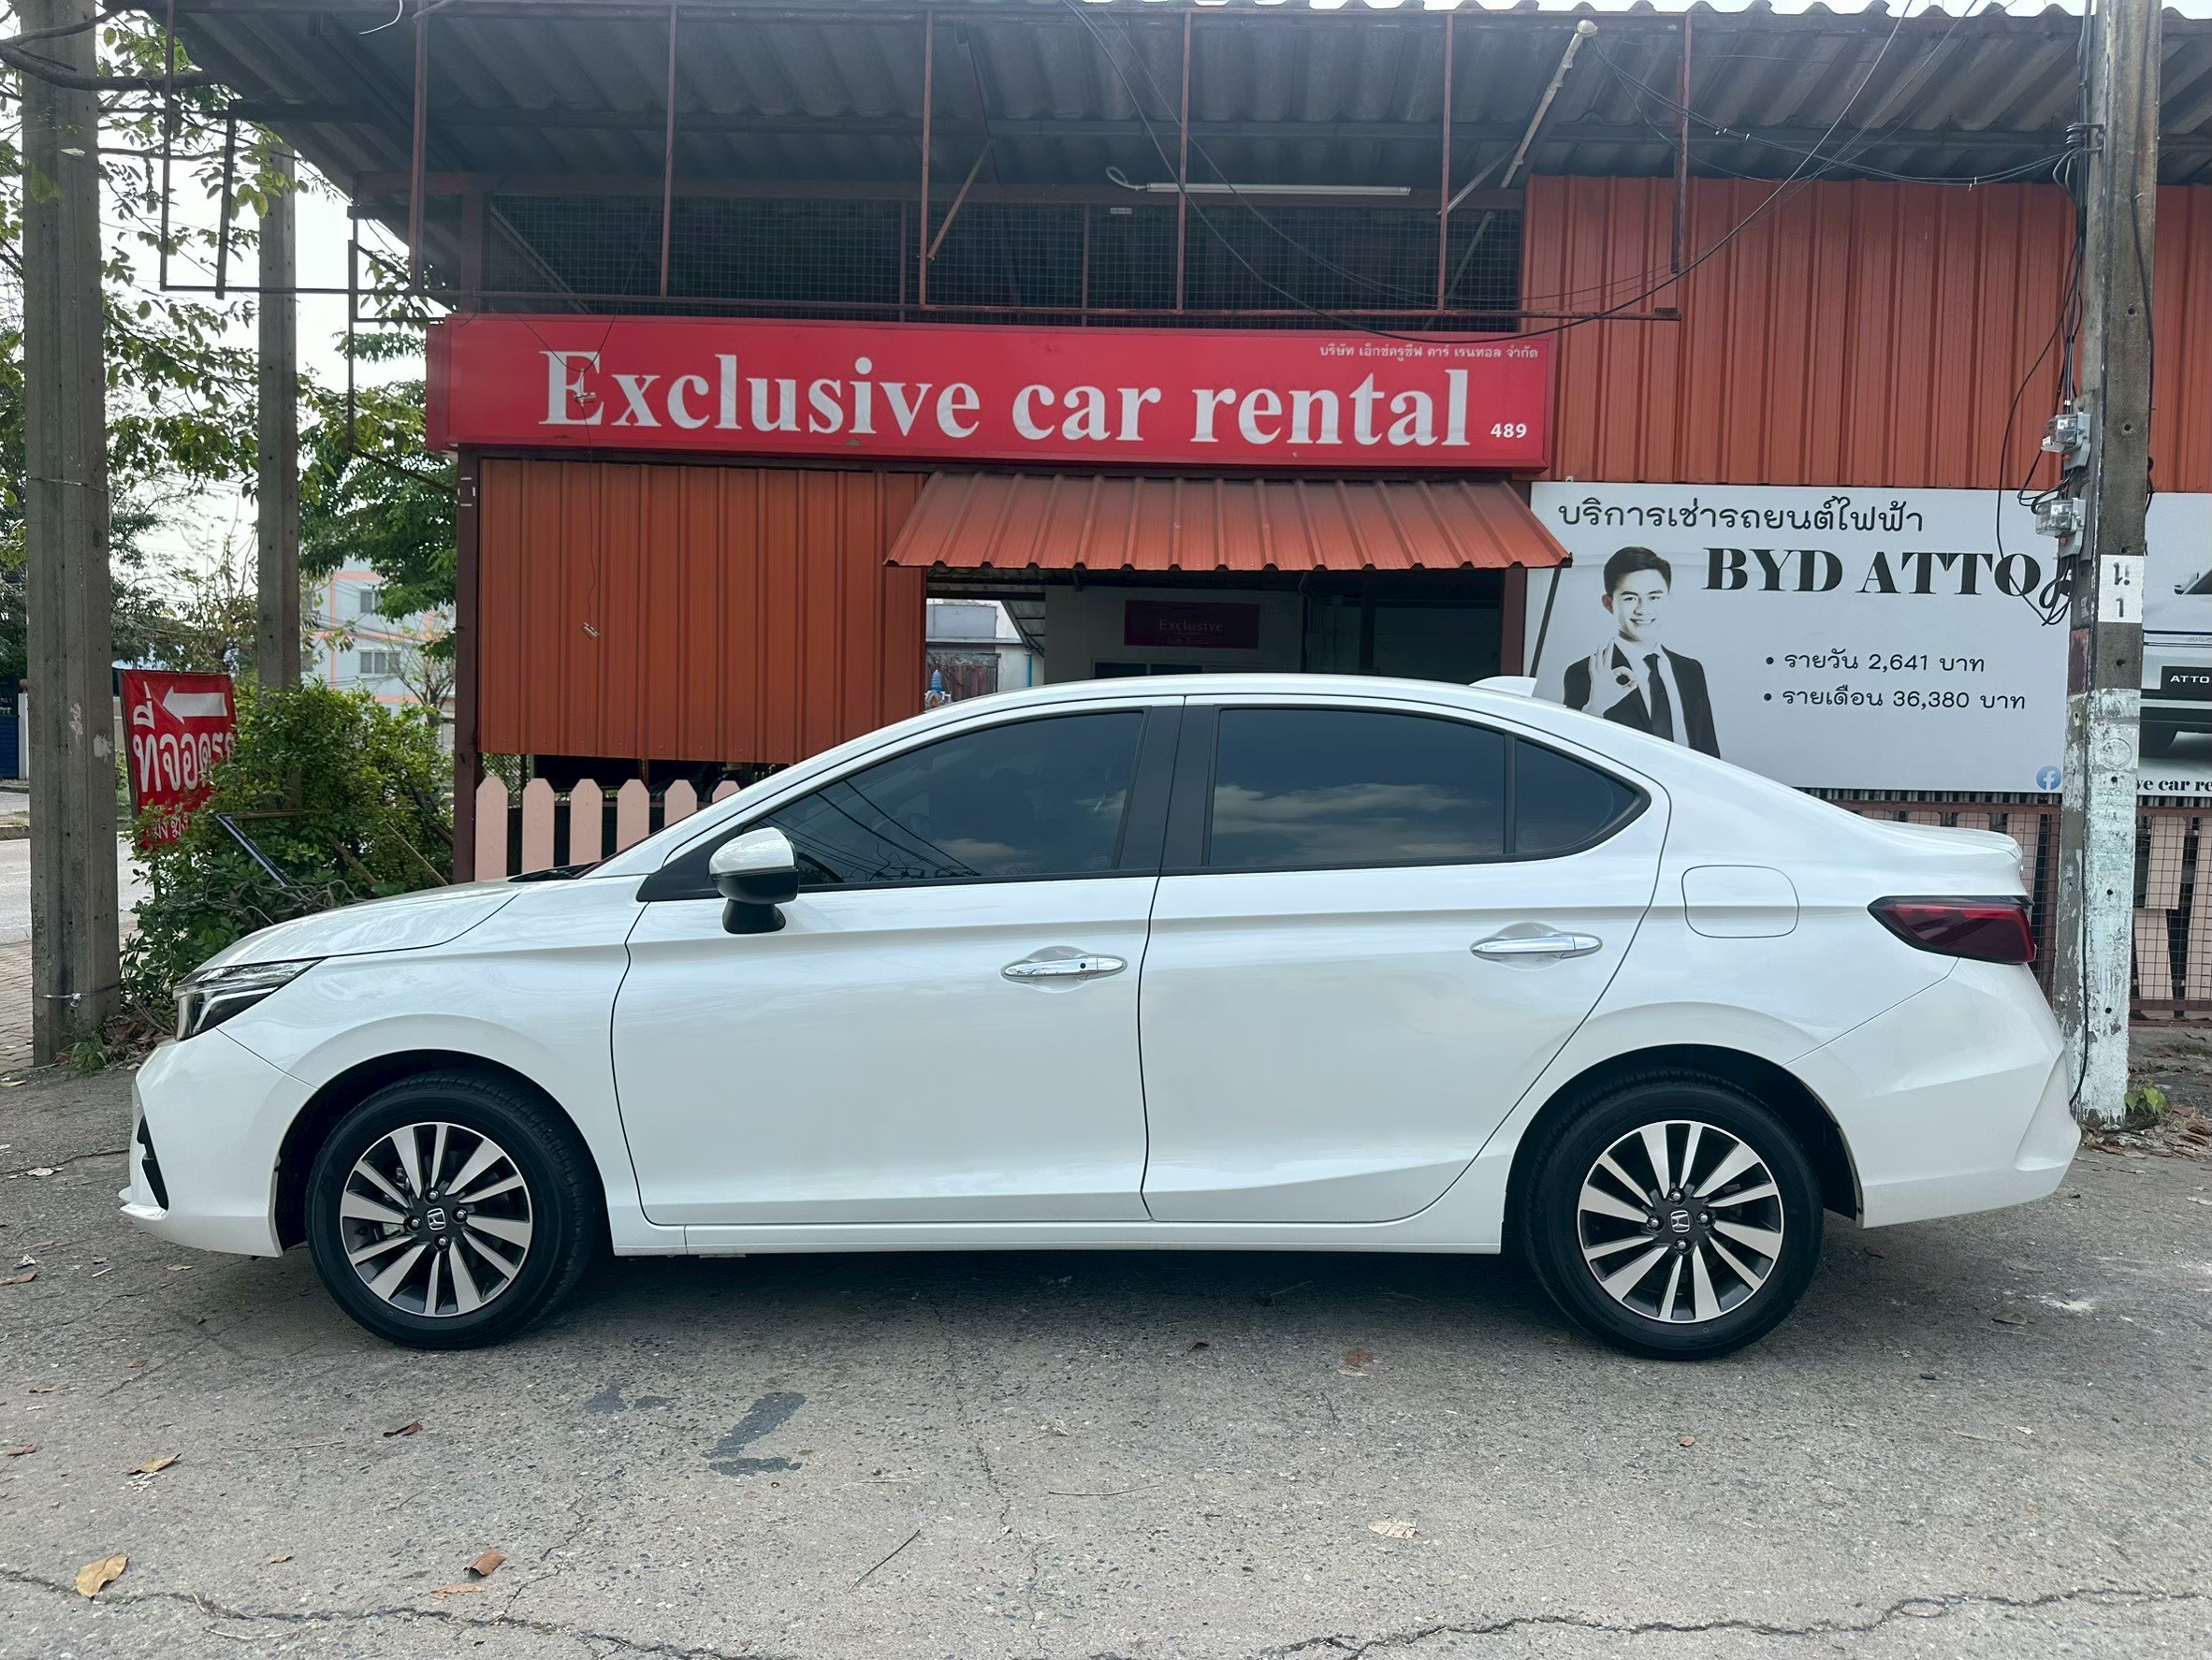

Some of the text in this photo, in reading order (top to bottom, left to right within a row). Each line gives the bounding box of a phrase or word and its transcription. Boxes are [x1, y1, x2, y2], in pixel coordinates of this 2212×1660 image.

[1319, 343, 1354, 357] บริษัท
[1427, 344, 1449, 357] คาร์
[1454, 346, 1502, 358] เรนทอล
[1506, 344, 1538, 358] จำกัด
[537, 349, 1471, 446] Exclusive car rental
[1490, 423, 1527, 439] 489
[1558, 495, 1924, 532] บริการเช่ารถยนต์ไฟฟ้า
[1701, 546, 2042, 597] BYD ATTO
[1159, 619, 1223, 632] Exclusive
[1783, 648, 1985, 673] รายวัน 2,641 บาท
[2170, 675, 2210, 684] ATTO
[1782, 684, 2026, 710] รายเดือน 36,380 บาท
[2158, 779, 2190, 792] car
